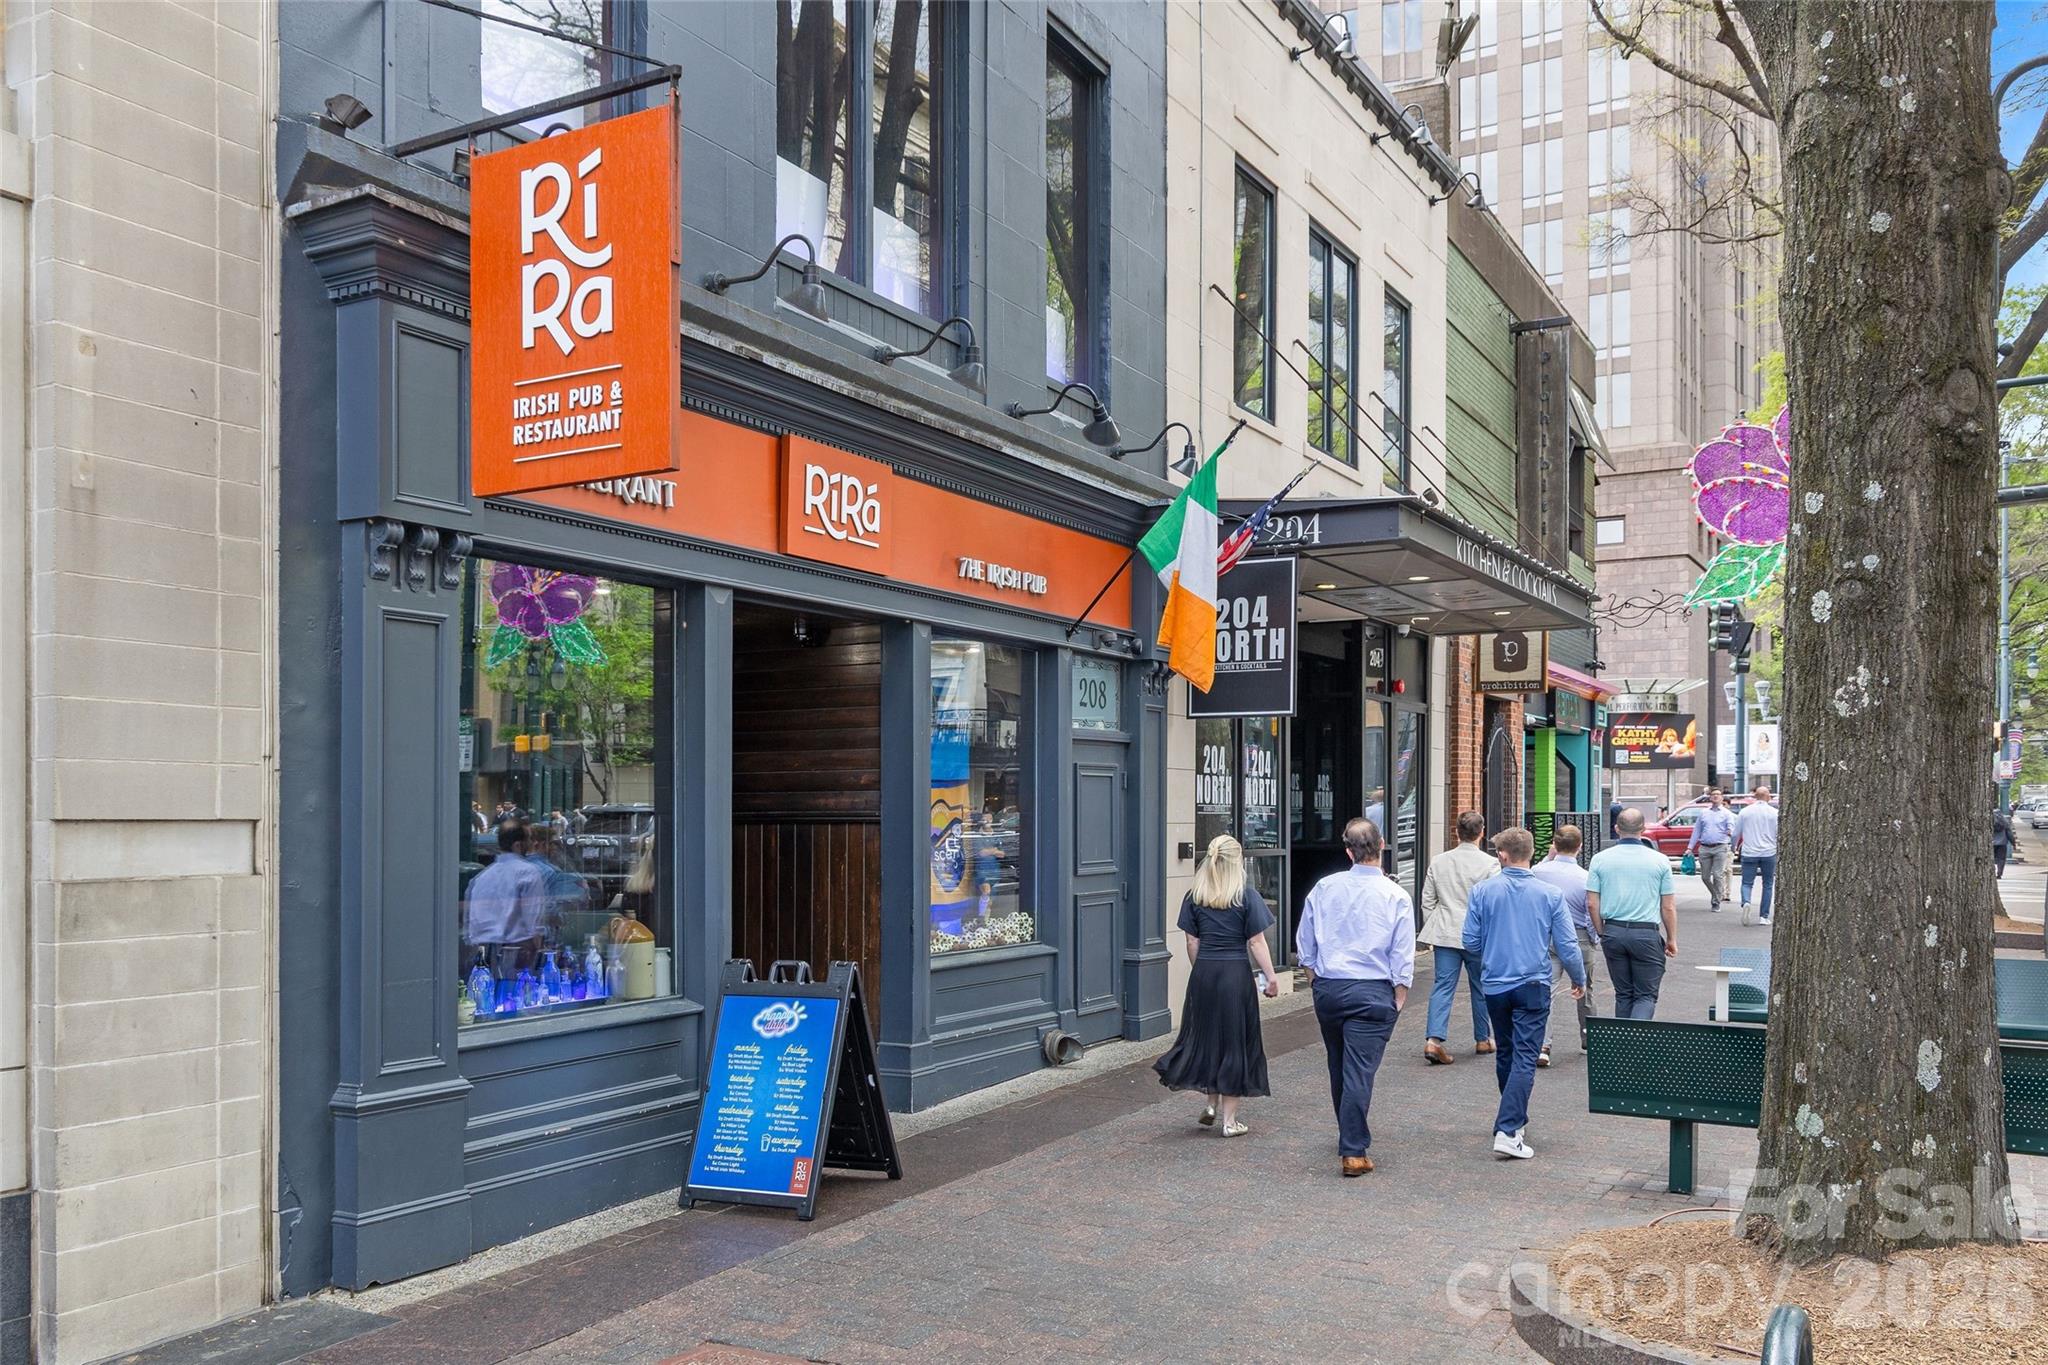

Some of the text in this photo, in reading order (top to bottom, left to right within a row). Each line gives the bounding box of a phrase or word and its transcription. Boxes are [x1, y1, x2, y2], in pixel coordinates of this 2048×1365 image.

[513, 380, 623, 419] IRISH PUB &
[513, 408, 623, 446] RESTAURANT
[1264, 512, 1323, 545] 204
[959, 556, 1047, 595] THE IRISH PUB
[1456, 535, 1557, 606] KITCHEN & COCKTAILS
[1216, 595, 1268, 630] 204
[1216, 627, 1285, 662] ORTH
[1241, 662, 1267, 670] COCKTAILS
[1079, 678, 1107, 710] 208
[1481, 681, 1540, 690] prohibition
[1616, 702, 1653, 711] PERFORMING
[1611, 737, 1660, 745] GRIFFIN
[1618, 729, 1658, 737] KATHY
[1203, 744, 1226, 775] 204
[1251, 750, 1271, 777] 204
[1196, 774, 1232, 805] NORTH
[1245, 777, 1277, 806] NORTH
[734, 1042, 760, 1054] monday
[784, 1044, 808, 1057] friday
[776, 1076, 807, 1088] saturday
[718, 1104, 754, 1118] wednesday
[774, 1101, 799, 1114] sunday
[714, 1143, 745, 1156] thursday
[771, 1135, 803, 1149] everyday
